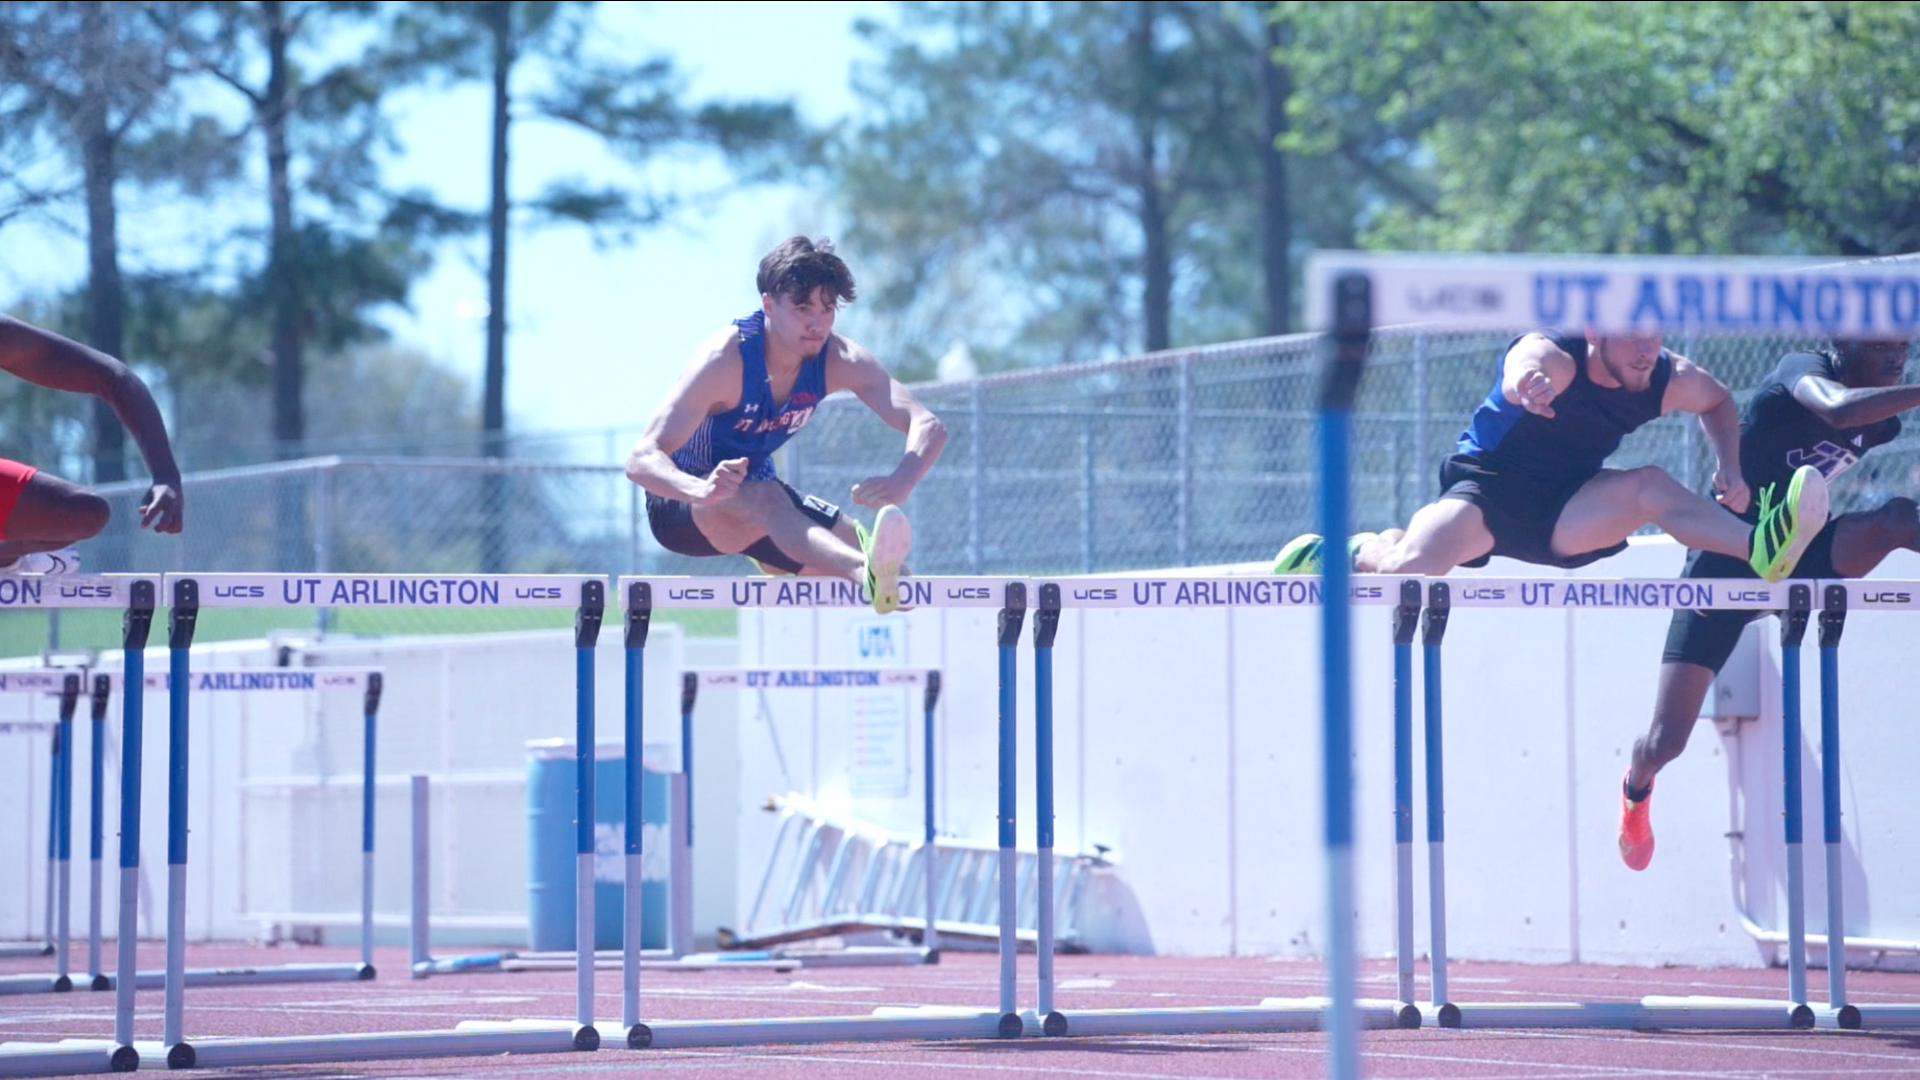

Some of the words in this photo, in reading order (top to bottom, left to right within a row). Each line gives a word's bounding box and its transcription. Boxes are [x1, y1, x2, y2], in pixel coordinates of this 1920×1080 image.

[1531, 273, 1613, 326] UT
[1629, 273, 1919, 328] ARLINGTO
[0, 579, 41, 605] ON
[60, 585, 112, 598] UCS
[215, 586, 264, 597] UCS
[283, 579, 321, 604] UT
[330, 579, 499, 604] ARLINGTON
[515, 587, 561, 599] UCS
[669, 588, 714, 599] UCS
[732, 582, 767, 606] UT
[776, 581, 932, 606] ARLINON
[947, 588, 990, 599] UCS
[1074, 589, 1117, 600] UCS
[1134, 582, 1166, 605] UT
[1175, 581, 1323, 605] ARLINGTON
[1463, 589, 1506, 600] UCS
[1521, 583, 1555, 606] UT
[1563, 583, 1713, 607] ARLINGTON
[1728, 591, 1770, 602] UCS
[1863, 592, 1911, 603] UCS
[200, 672, 315, 690] ARLINGTON
[747, 671, 771, 686] UT
[776, 671, 880, 686] ARLINGTON
